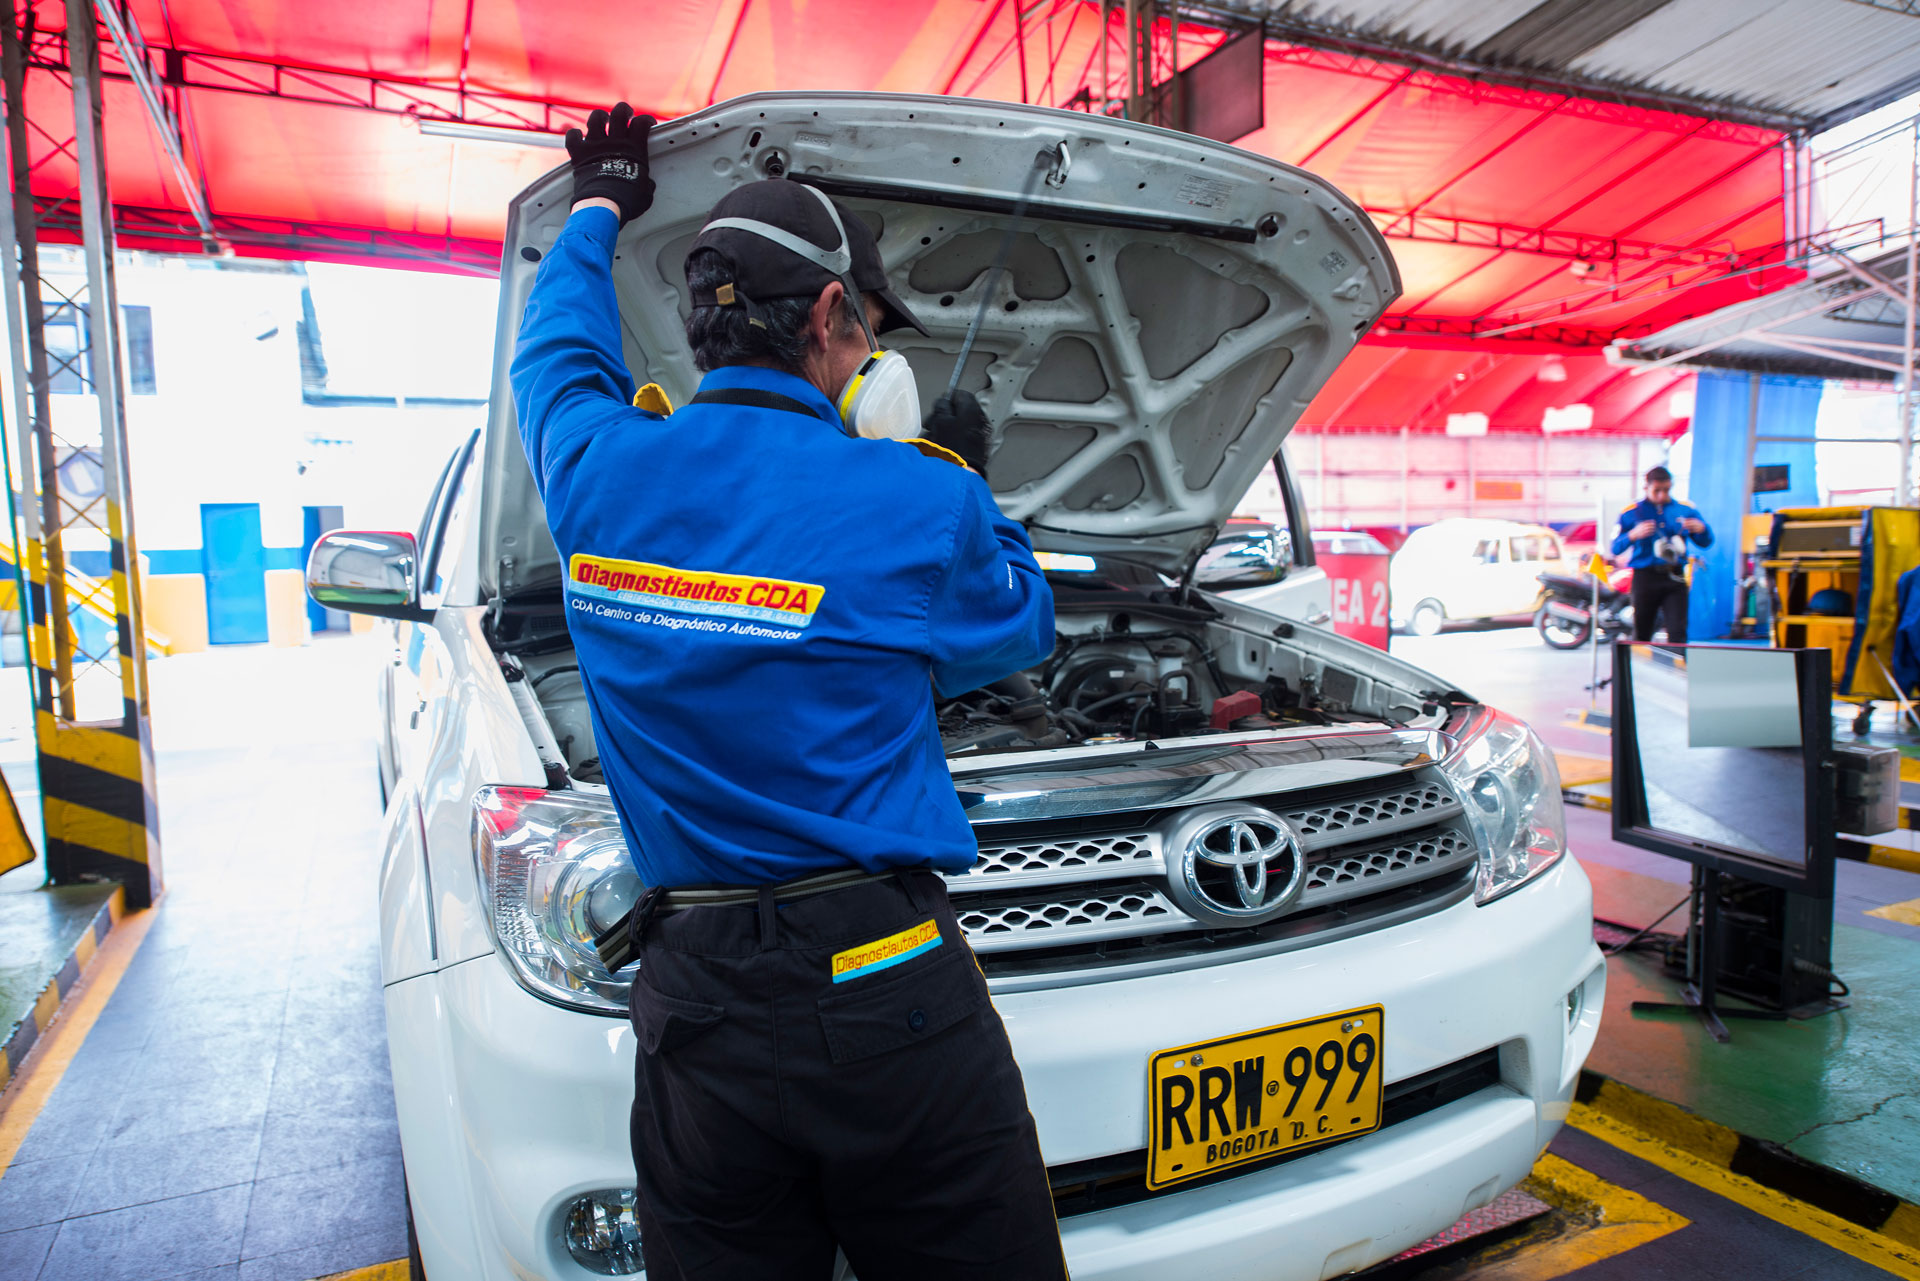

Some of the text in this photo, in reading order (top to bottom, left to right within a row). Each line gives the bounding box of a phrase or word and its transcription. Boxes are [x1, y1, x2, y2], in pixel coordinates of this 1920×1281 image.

[577, 562, 808, 613] Diagnostiautos CDA
[1328, 577, 1386, 628] EA 2
[572, 598, 802, 640] CDA Centro de Diagnóstico Automotor
[919, 922, 938, 943] CDA
[1161, 1032, 1376, 1151] RRW 999
[1206, 1127, 1279, 1164] BOGOTA
